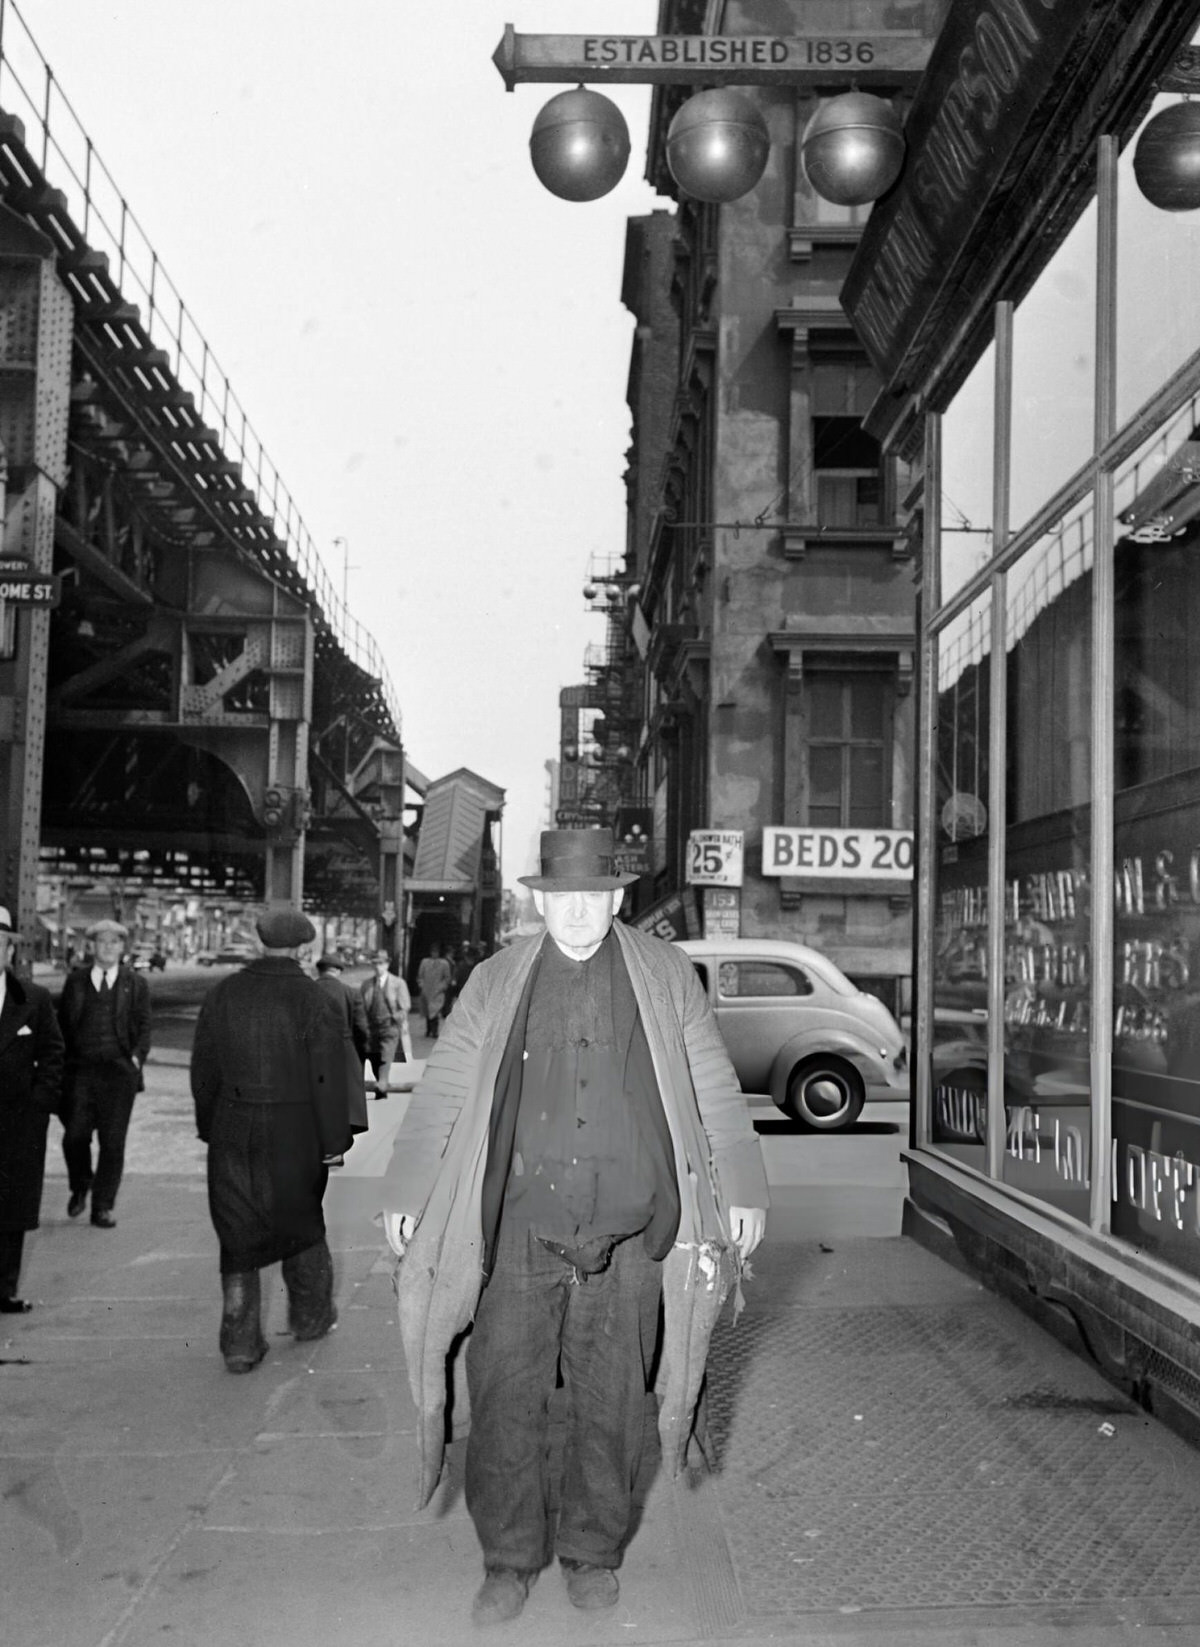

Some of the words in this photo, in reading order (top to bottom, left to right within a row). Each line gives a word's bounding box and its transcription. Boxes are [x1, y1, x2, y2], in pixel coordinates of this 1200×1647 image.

[582, 39, 789, 63] ESTABLISHED
[806, 40, 875, 64] 1836
[772, 833, 862, 869] BEDS
[871, 835, 914, 870] 20
